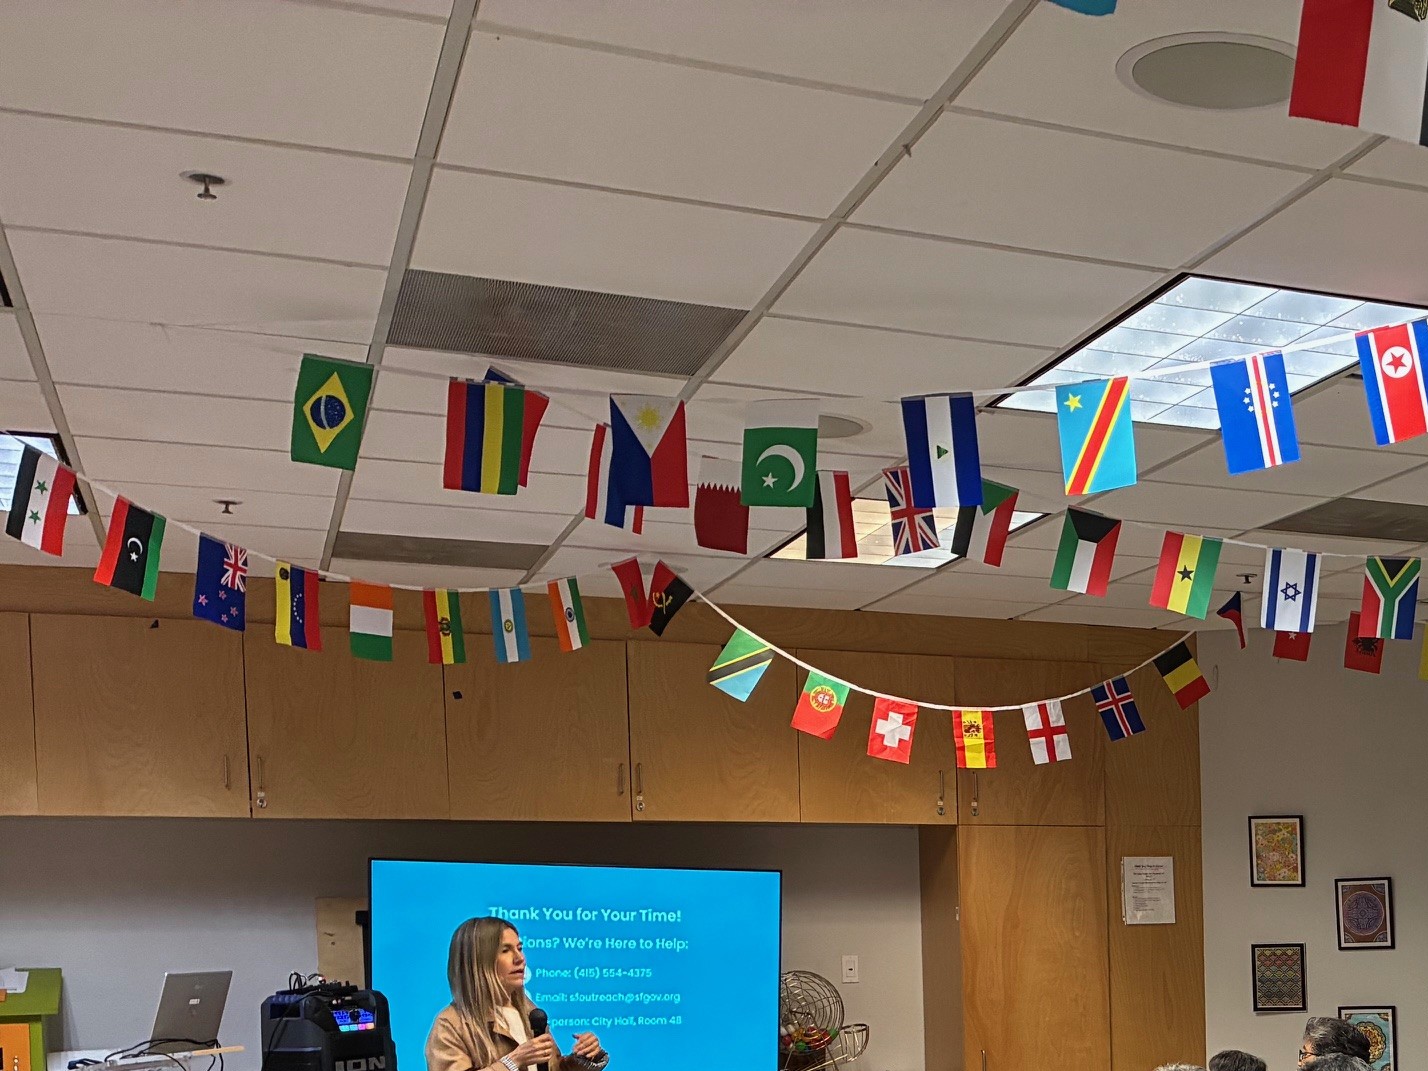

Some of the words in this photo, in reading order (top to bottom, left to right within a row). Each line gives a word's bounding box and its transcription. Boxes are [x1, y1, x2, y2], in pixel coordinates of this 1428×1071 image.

[488, 906, 539, 921] Thank
[542, 907, 573, 921] You
[576, 907, 598, 920] for
[601, 908, 637, 922] Your
[639, 908, 682, 922] Time!
[605, 937, 636, 949] Here
[639, 937, 653, 949] to
[655, 937, 689, 952] Help:
[535, 967, 571, 978] Phone:
[574, 966, 600, 979] (415)
[602, 967, 652, 978] 554-4375
[535, 992, 568, 1002] Email:
[591, 1016, 613, 1029] City
[638, 1016, 667, 1025] Room
